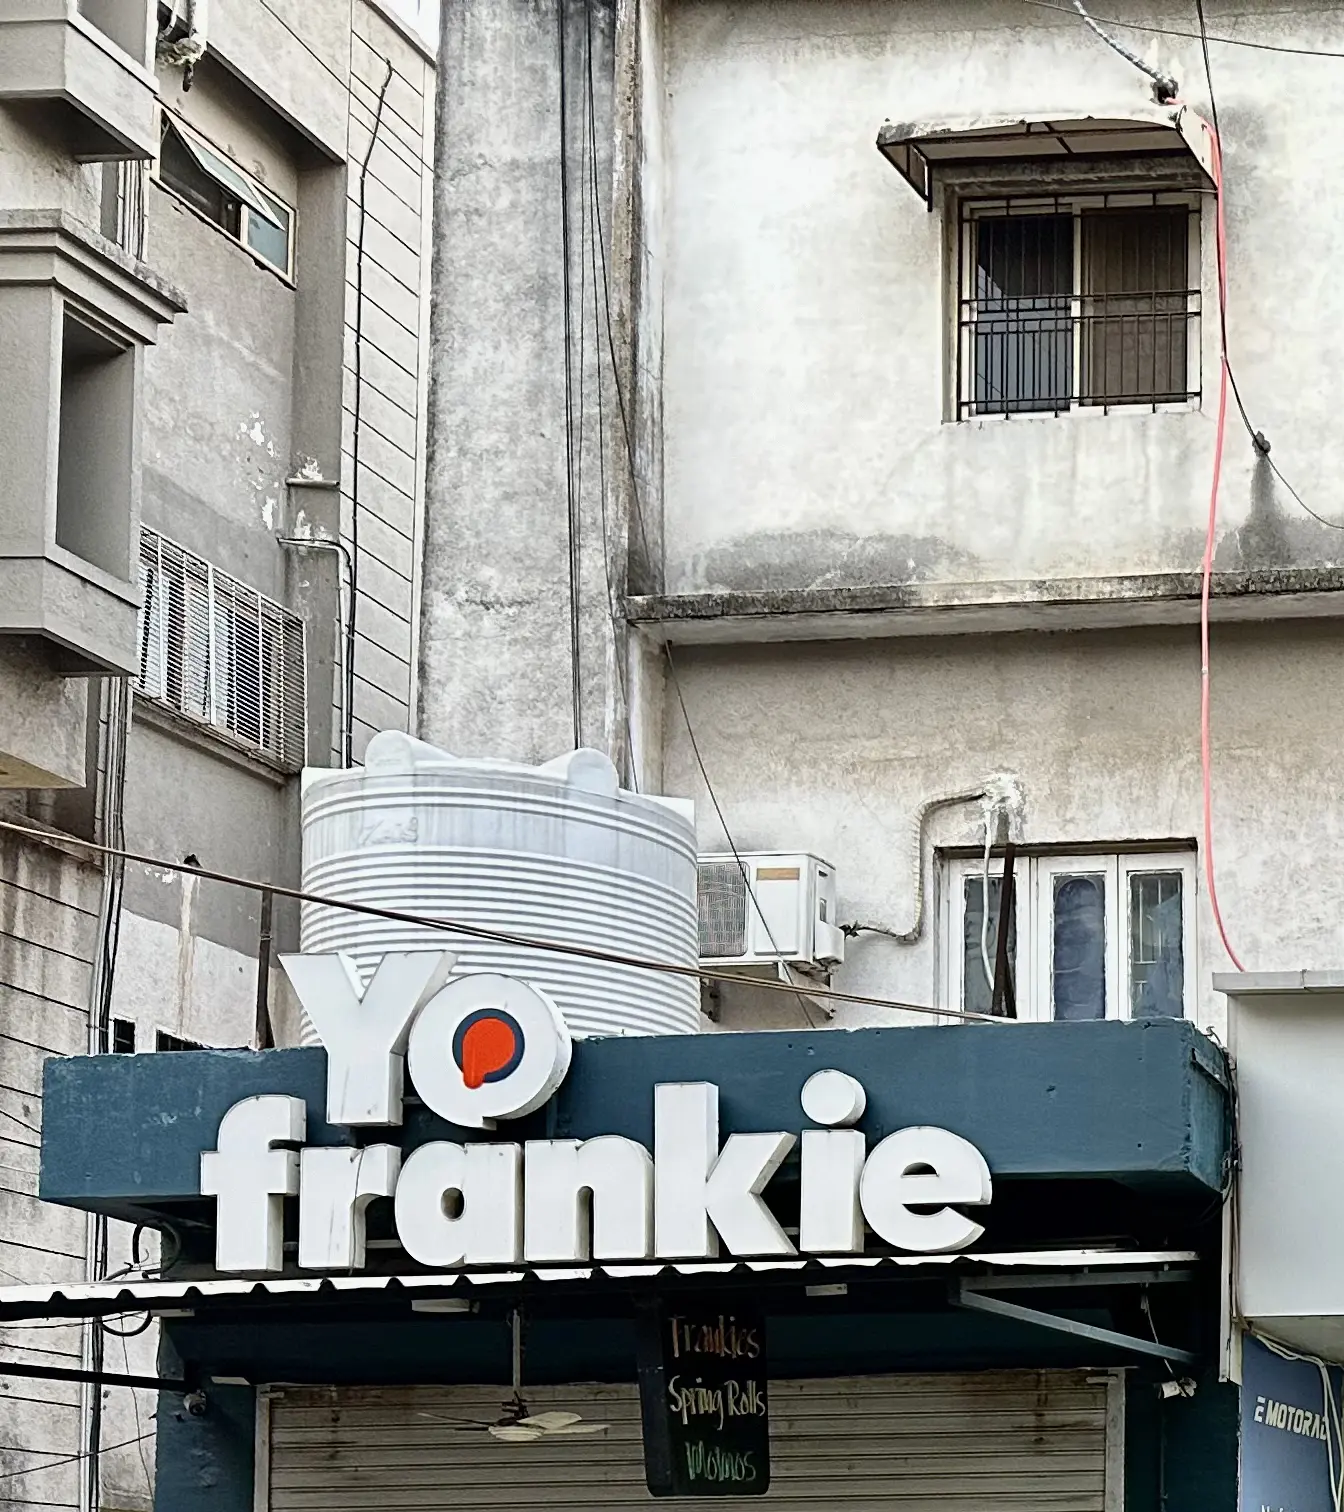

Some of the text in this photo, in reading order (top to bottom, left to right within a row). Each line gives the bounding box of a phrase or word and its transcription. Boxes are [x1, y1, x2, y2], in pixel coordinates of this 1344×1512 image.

[200, 1069, 992, 1272] frankie
[667, 1374, 767, 1431] Spring Rolls
